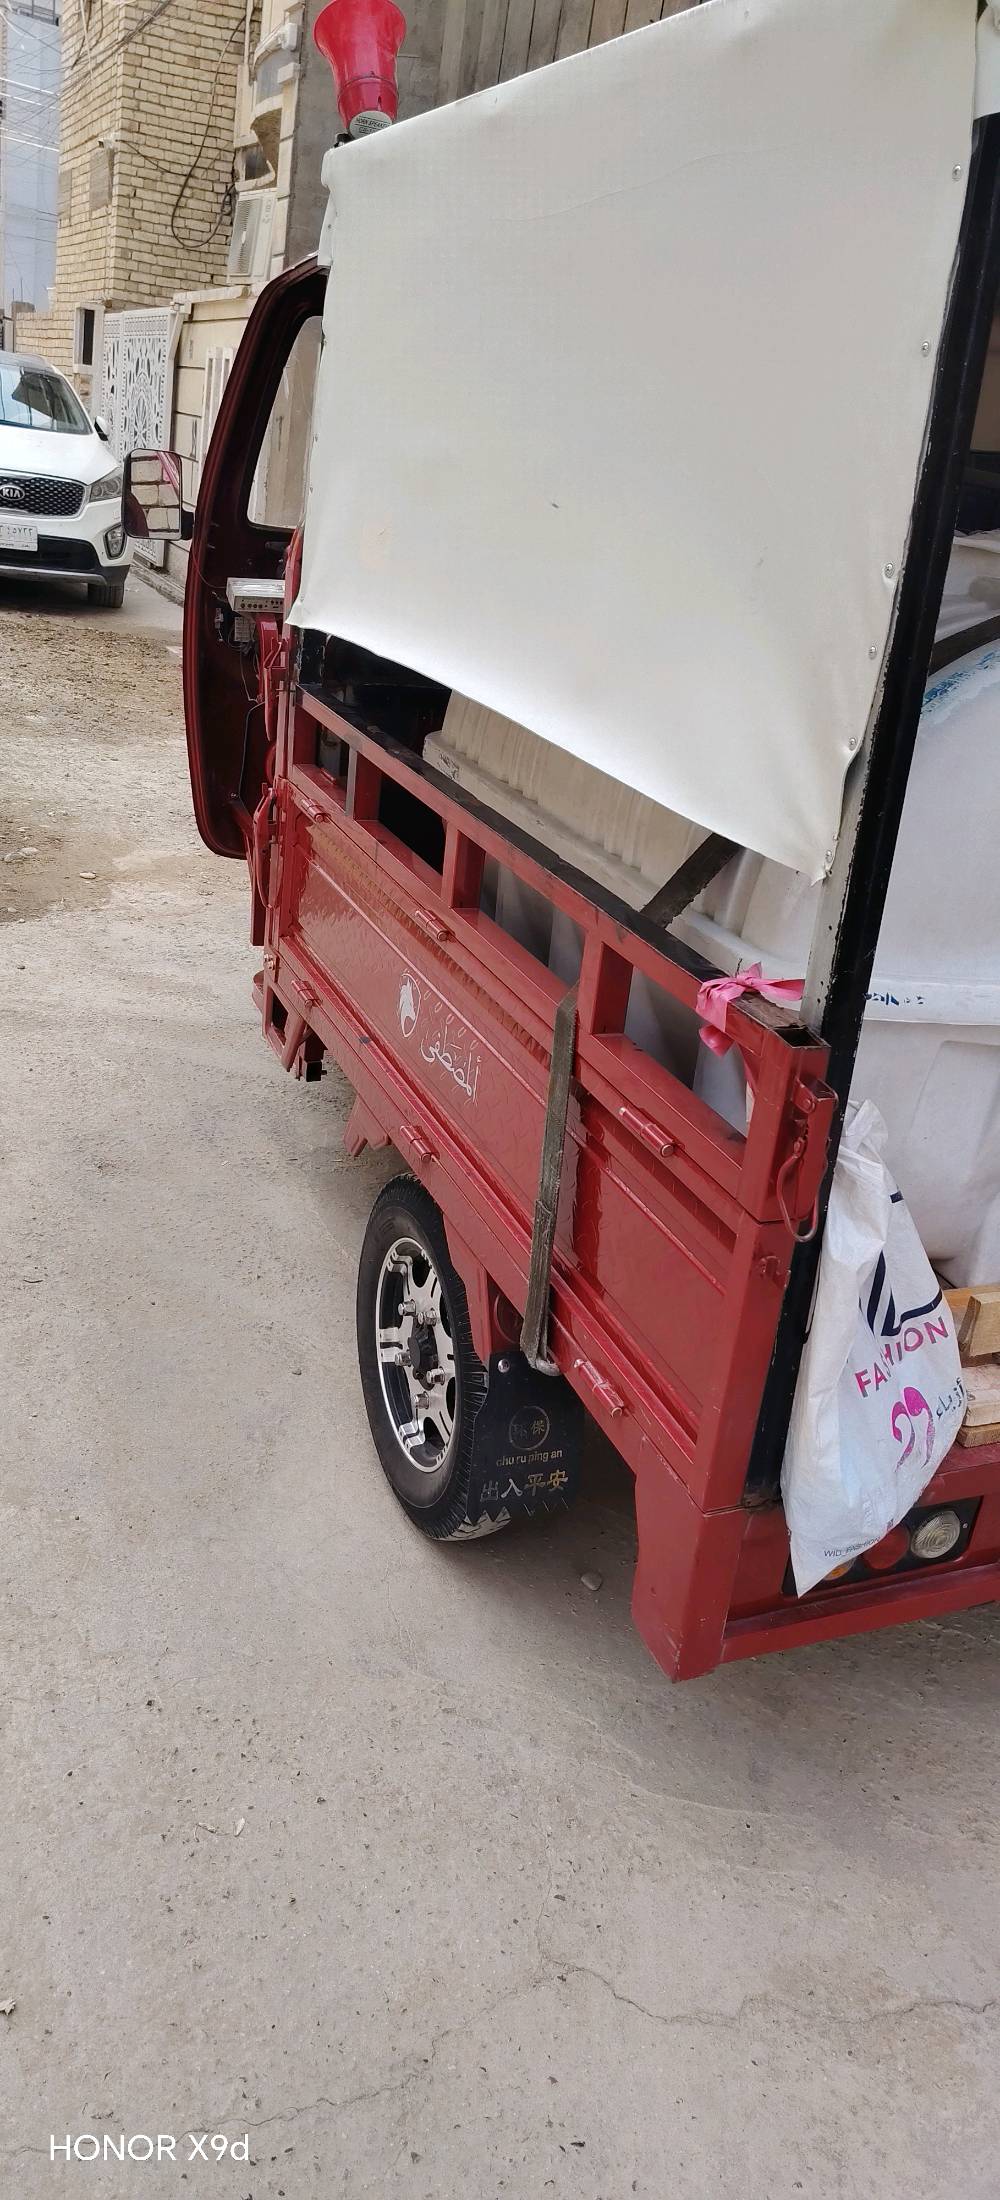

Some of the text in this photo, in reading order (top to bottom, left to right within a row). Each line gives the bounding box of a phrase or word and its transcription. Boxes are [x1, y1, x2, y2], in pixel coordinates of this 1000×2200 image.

[2, 488, 20, 498] KIA
[854, 1316, 949, 1398] FAHION
[550, 1450, 563, 1459] an
[480, 1470, 569, 1502] 出入平安
